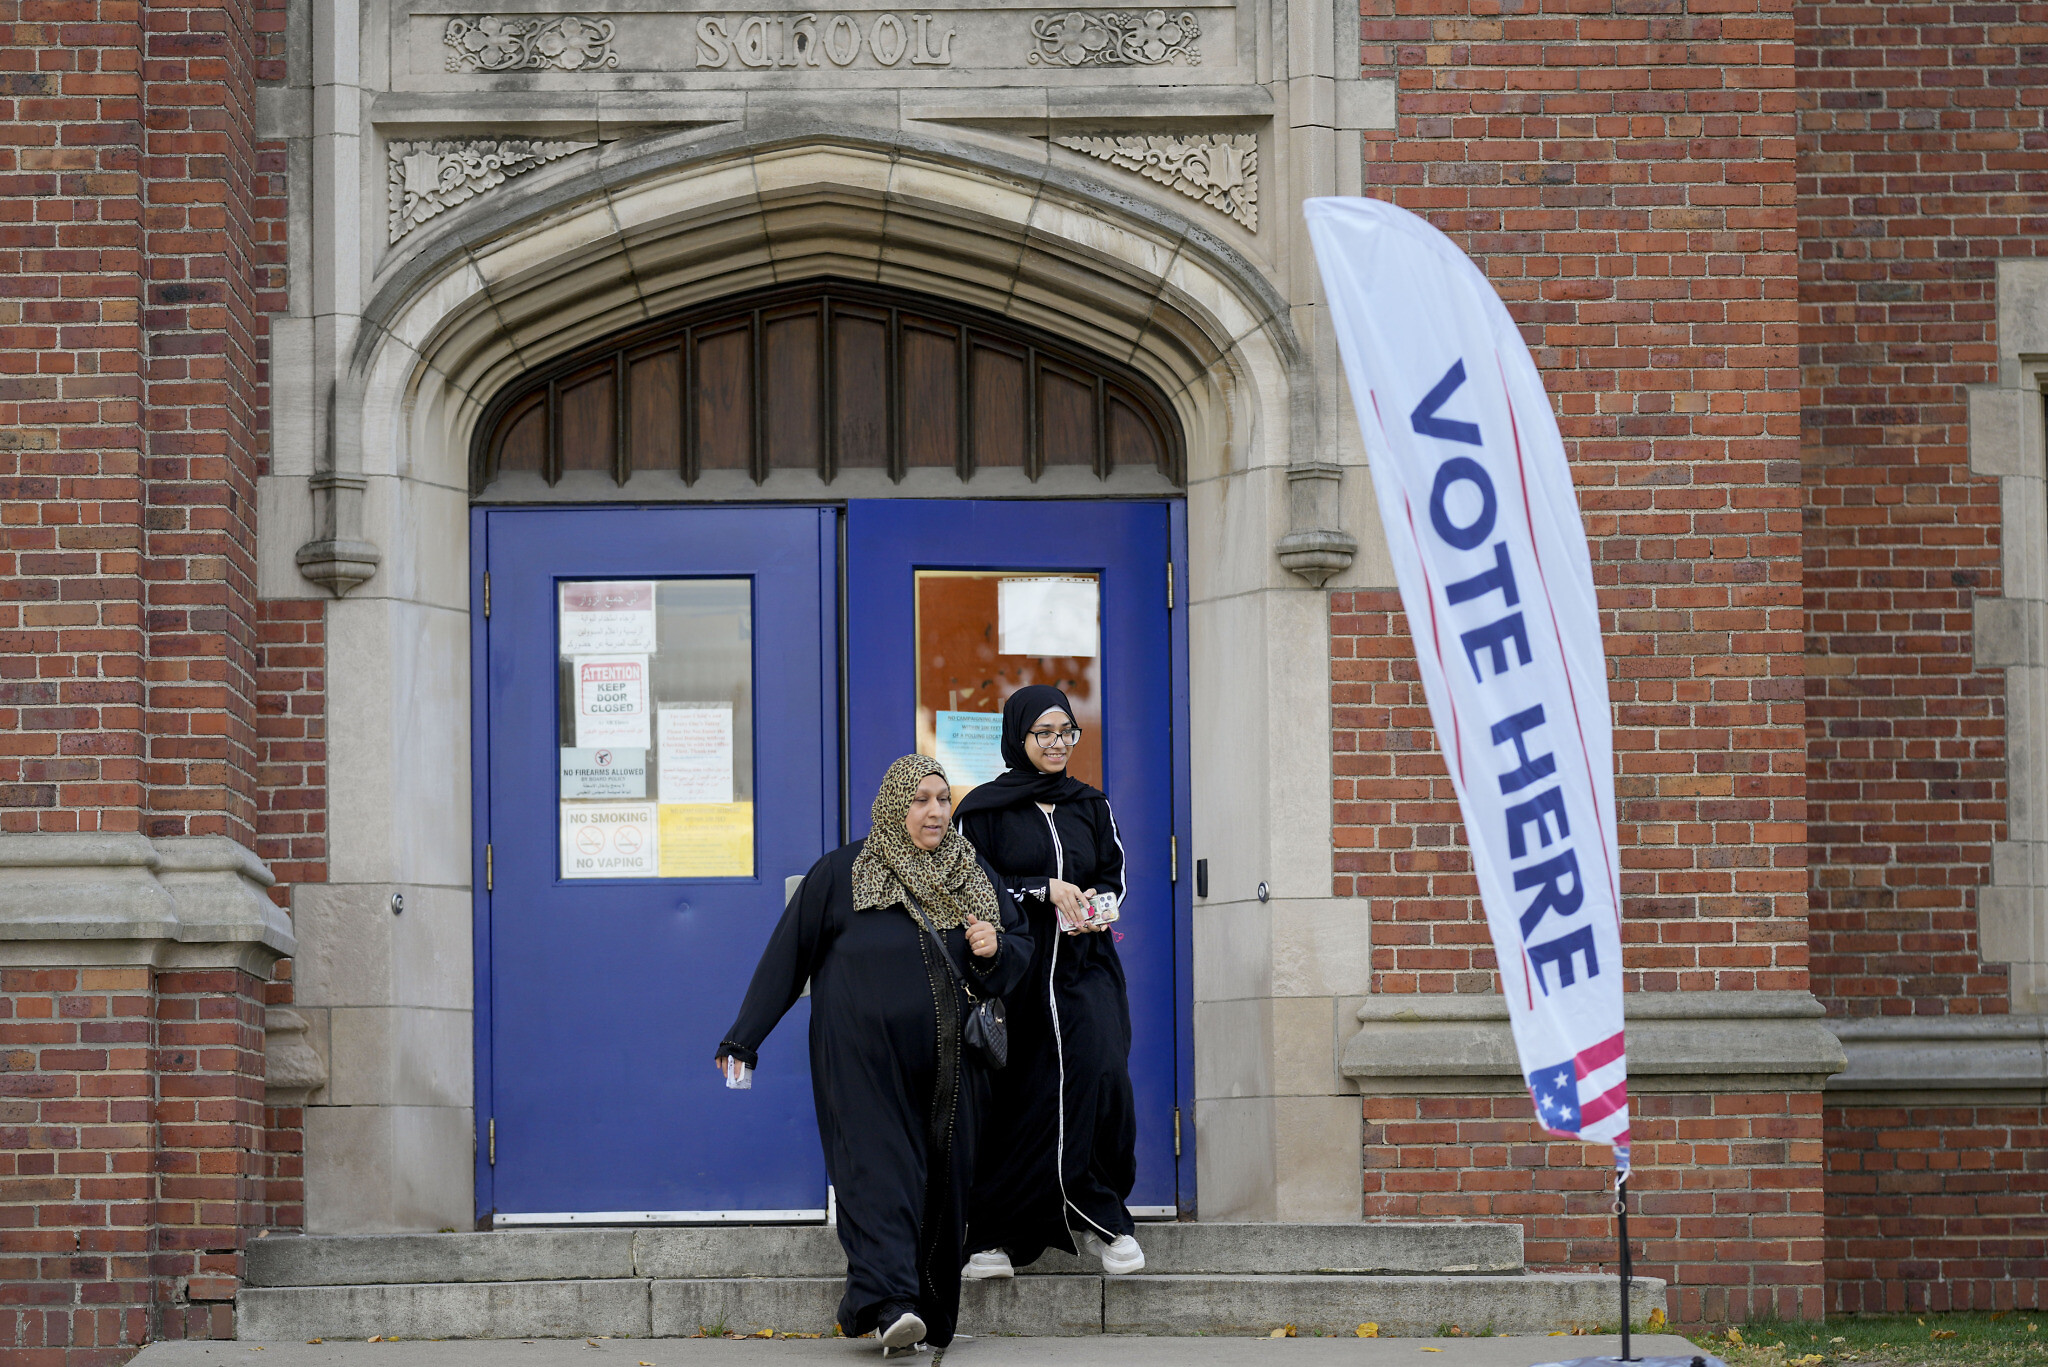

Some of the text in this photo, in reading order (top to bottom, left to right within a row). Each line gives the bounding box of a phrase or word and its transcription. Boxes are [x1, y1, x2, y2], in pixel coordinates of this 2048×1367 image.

[696, 13, 956, 68] SCHOOL
[583, 666, 640, 680] ATTENTION
[1411, 357, 1600, 996] VOTE HERE
[597, 683, 626, 692] KEEP
[596, 693, 627, 702] DOOR
[591, 703, 634, 713] CLOSED
[575, 768, 610, 776] FIREARMS
[611, 768, 644, 776] ALLOWED
[570, 812, 648, 824] NO SMOKING
[576, 857, 643, 868] NO VAPING
